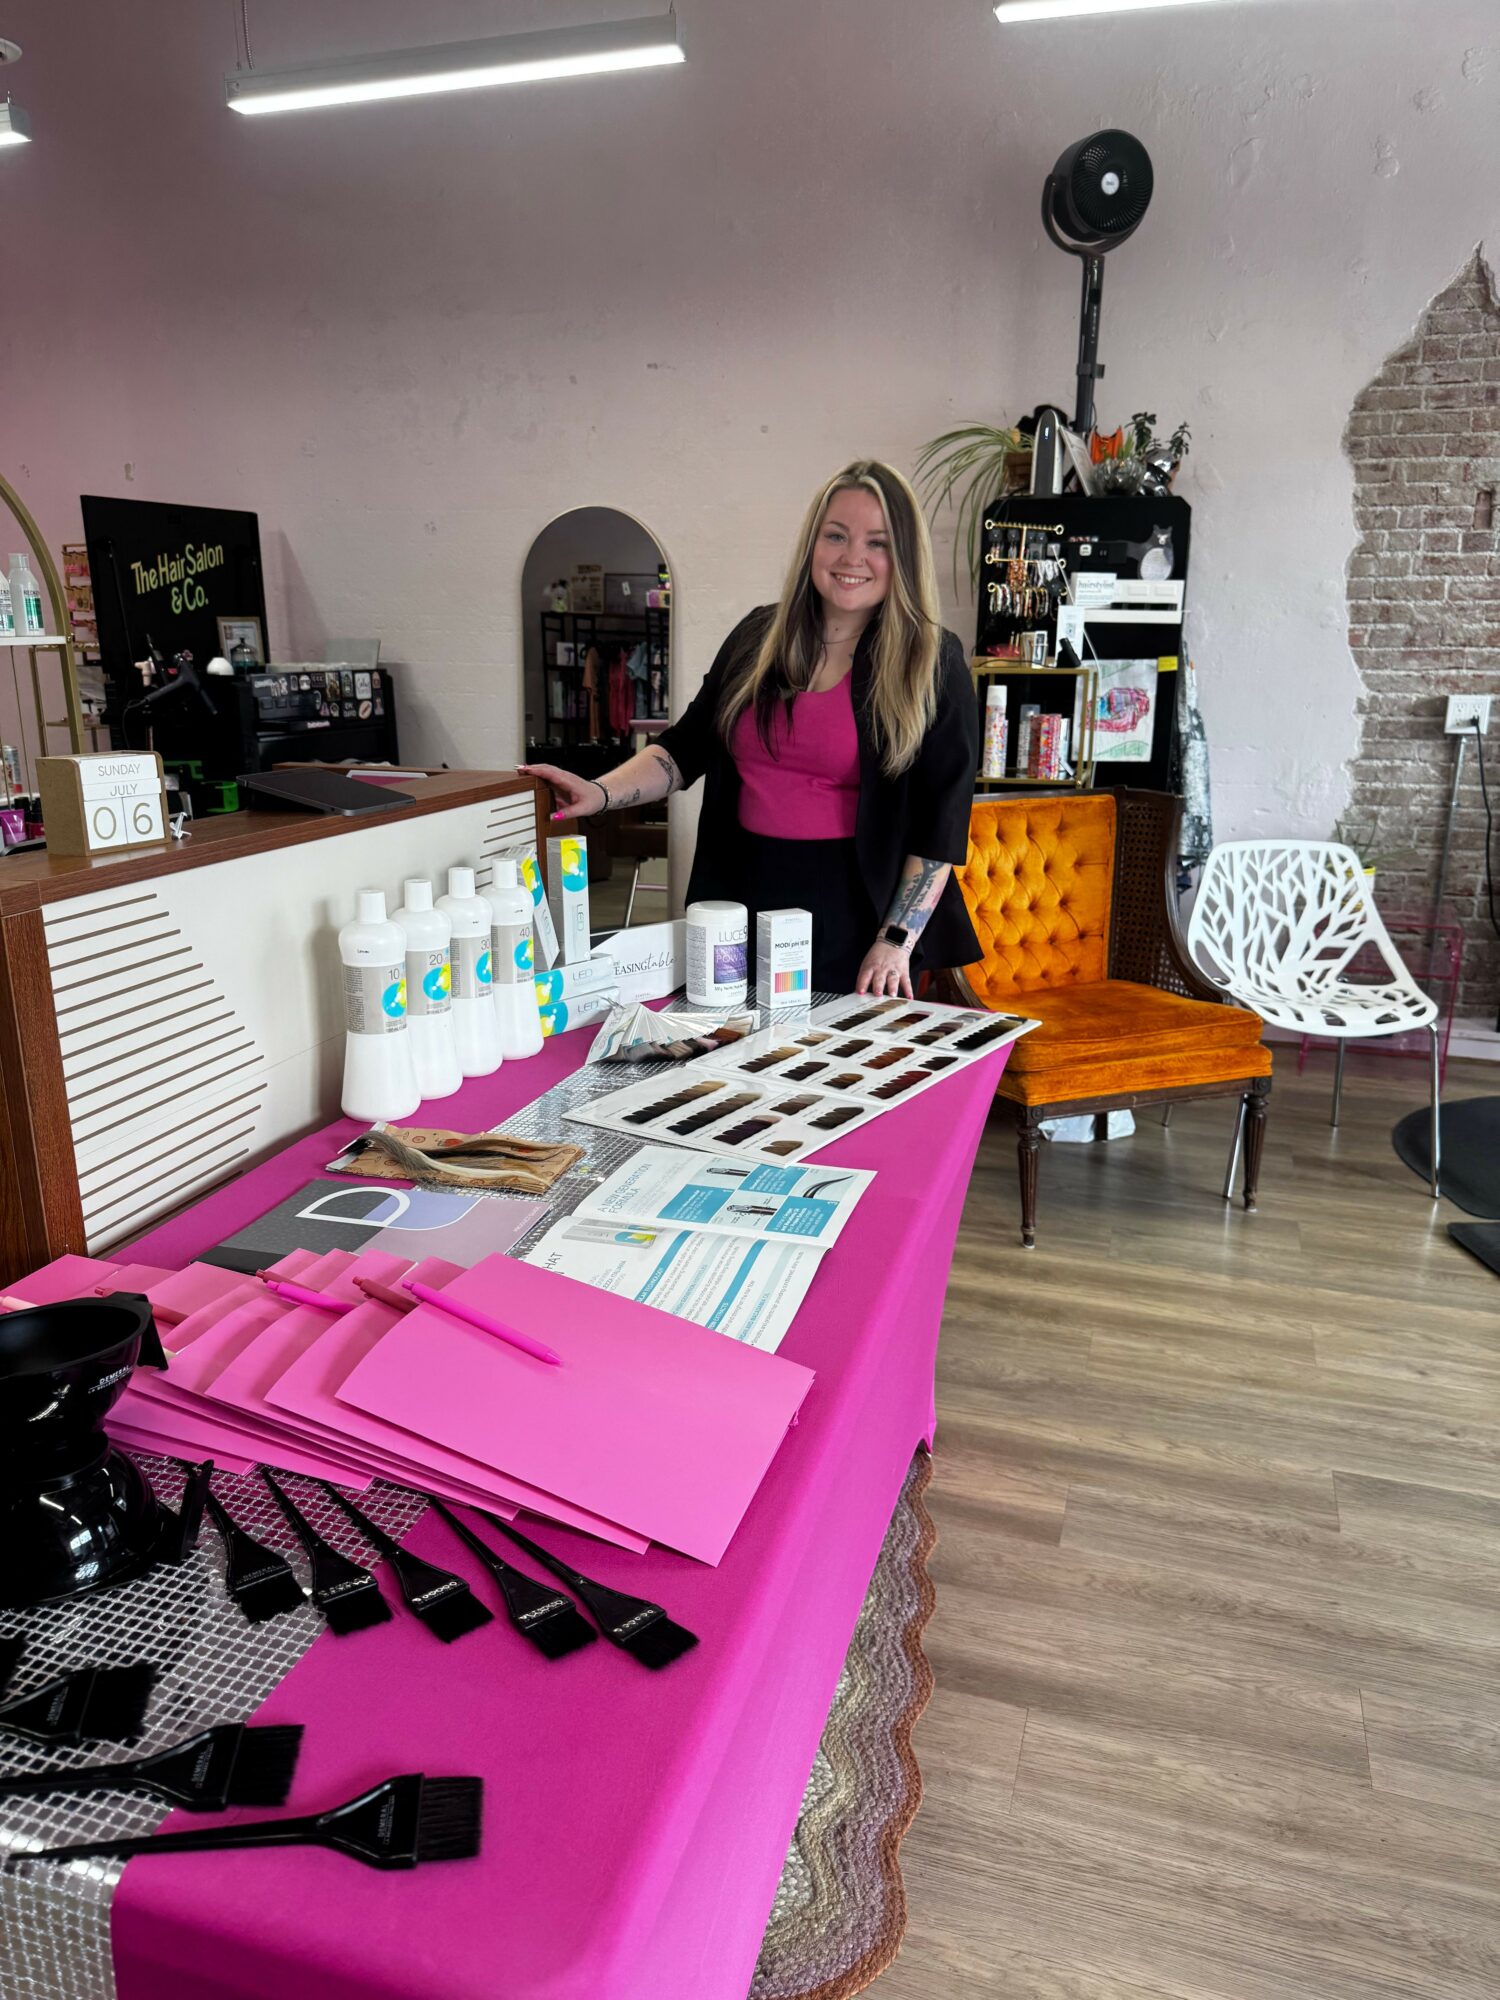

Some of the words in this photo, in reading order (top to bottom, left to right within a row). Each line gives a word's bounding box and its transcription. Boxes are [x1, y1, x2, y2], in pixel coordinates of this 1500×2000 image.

[130, 561, 159, 595] The
[157, 553, 186, 587] Hair
[185, 543, 224, 575] Salon
[171, 586, 183, 614] &
[183, 577, 209, 611] Co.
[98, 763, 141, 777] SUNDAY
[110, 783, 138, 797] JULY
[519, 926, 531, 937] 40
[429, 953, 443, 966] 20
[388, 968, 400, 981] 10
[572, 968, 593, 981] LED
[614, 961, 648, 976] EASING
[577, 1000, 599, 1013] LED
[543, 1252, 563, 1270] HAT
